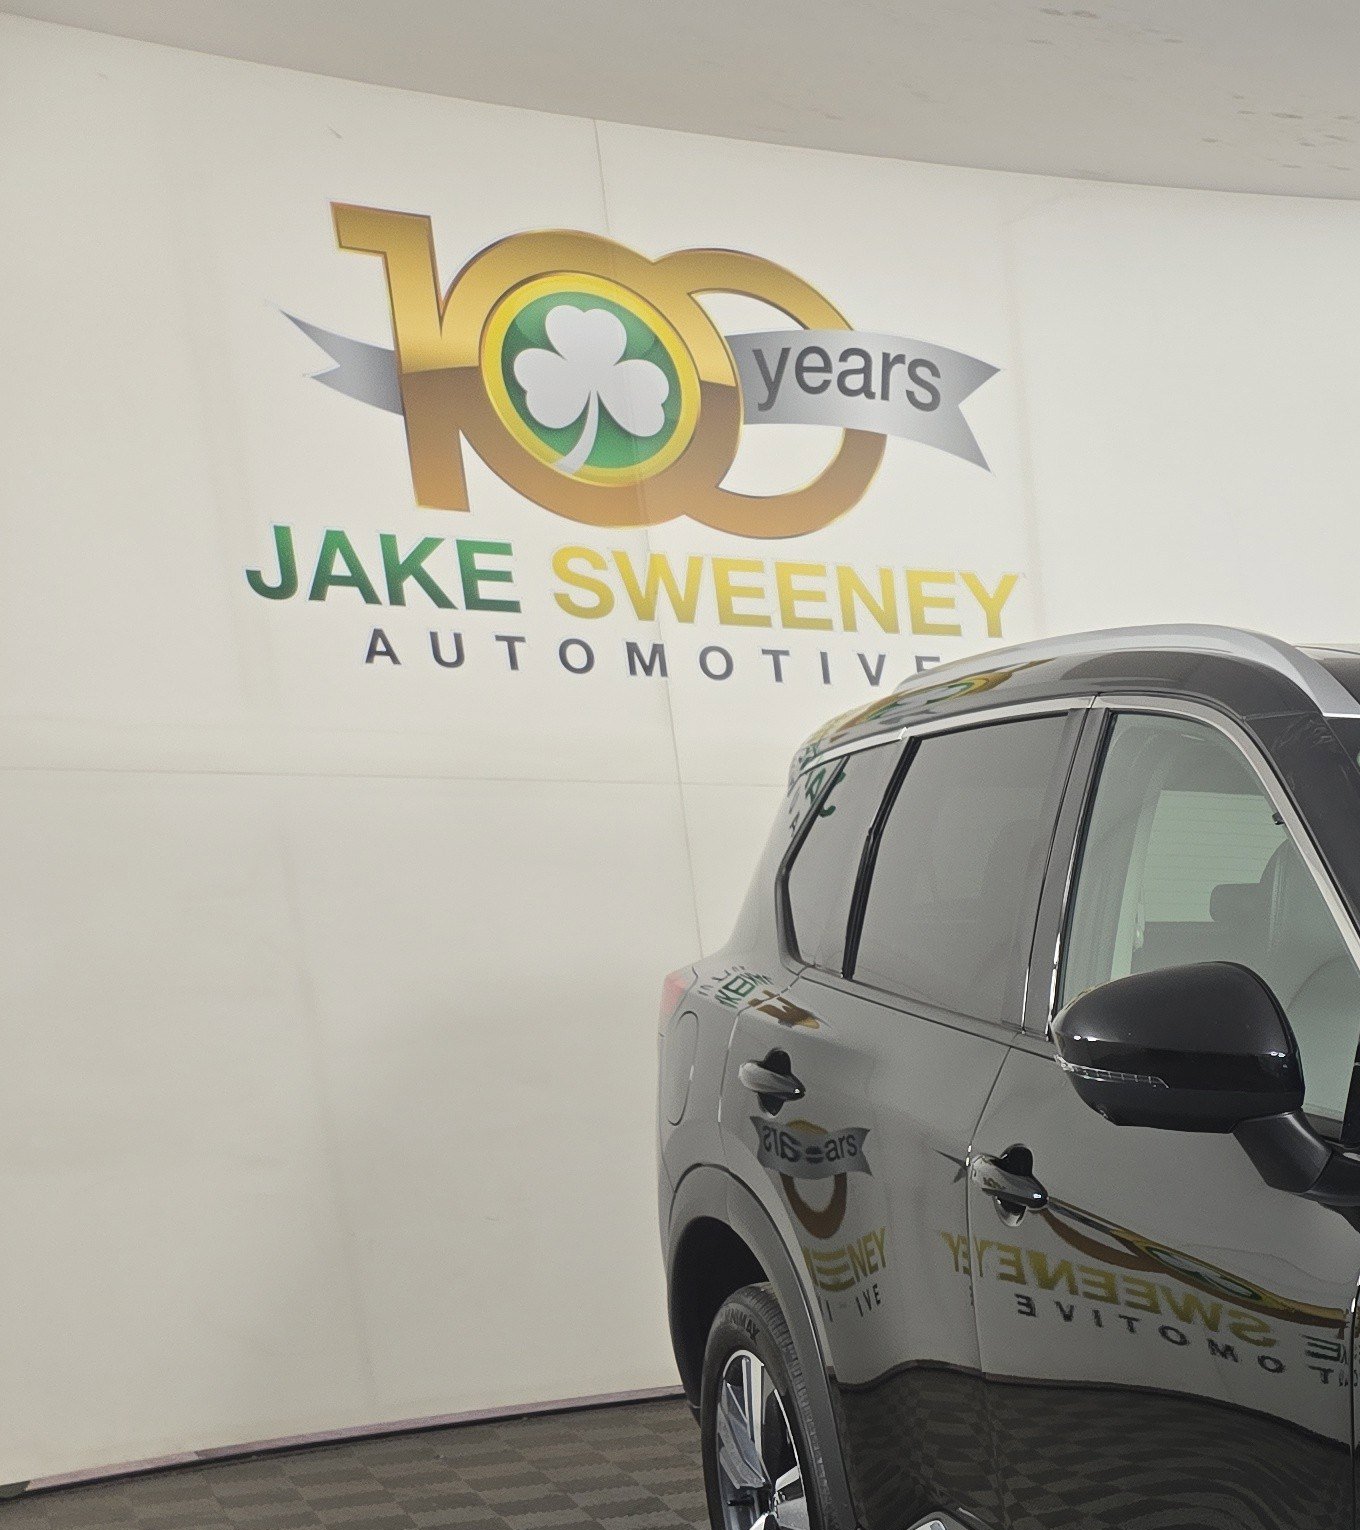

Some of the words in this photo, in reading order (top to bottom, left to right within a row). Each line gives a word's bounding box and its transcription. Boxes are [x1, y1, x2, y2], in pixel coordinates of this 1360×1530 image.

[752, 344, 943, 412] years
[245, 524, 522, 613] JAKE
[551, 545, 1020, 638] SWEENEY
